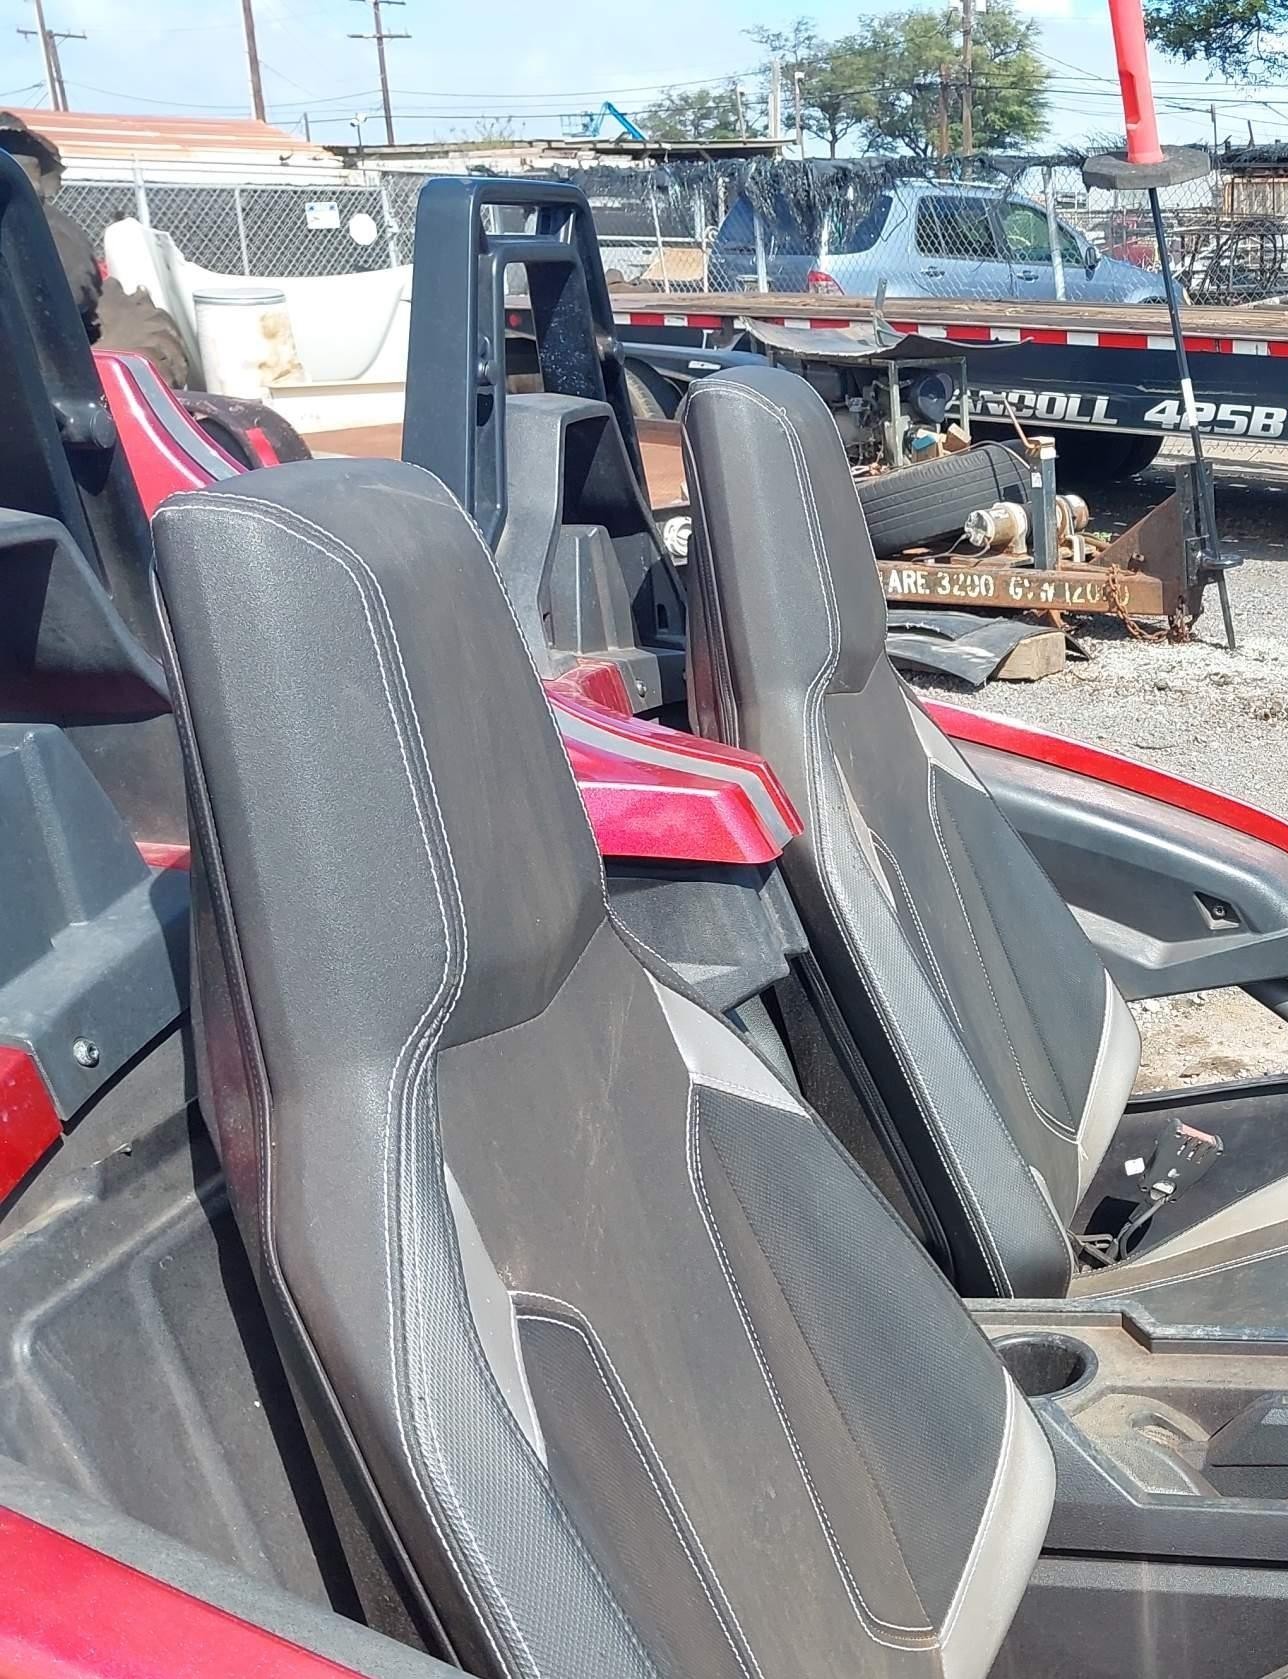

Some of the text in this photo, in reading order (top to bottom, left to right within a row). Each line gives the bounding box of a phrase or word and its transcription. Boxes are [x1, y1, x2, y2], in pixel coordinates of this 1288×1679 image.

[944, 388, 1288, 438] ANDOLL 425B
[879, 569, 929, 596] ARE
